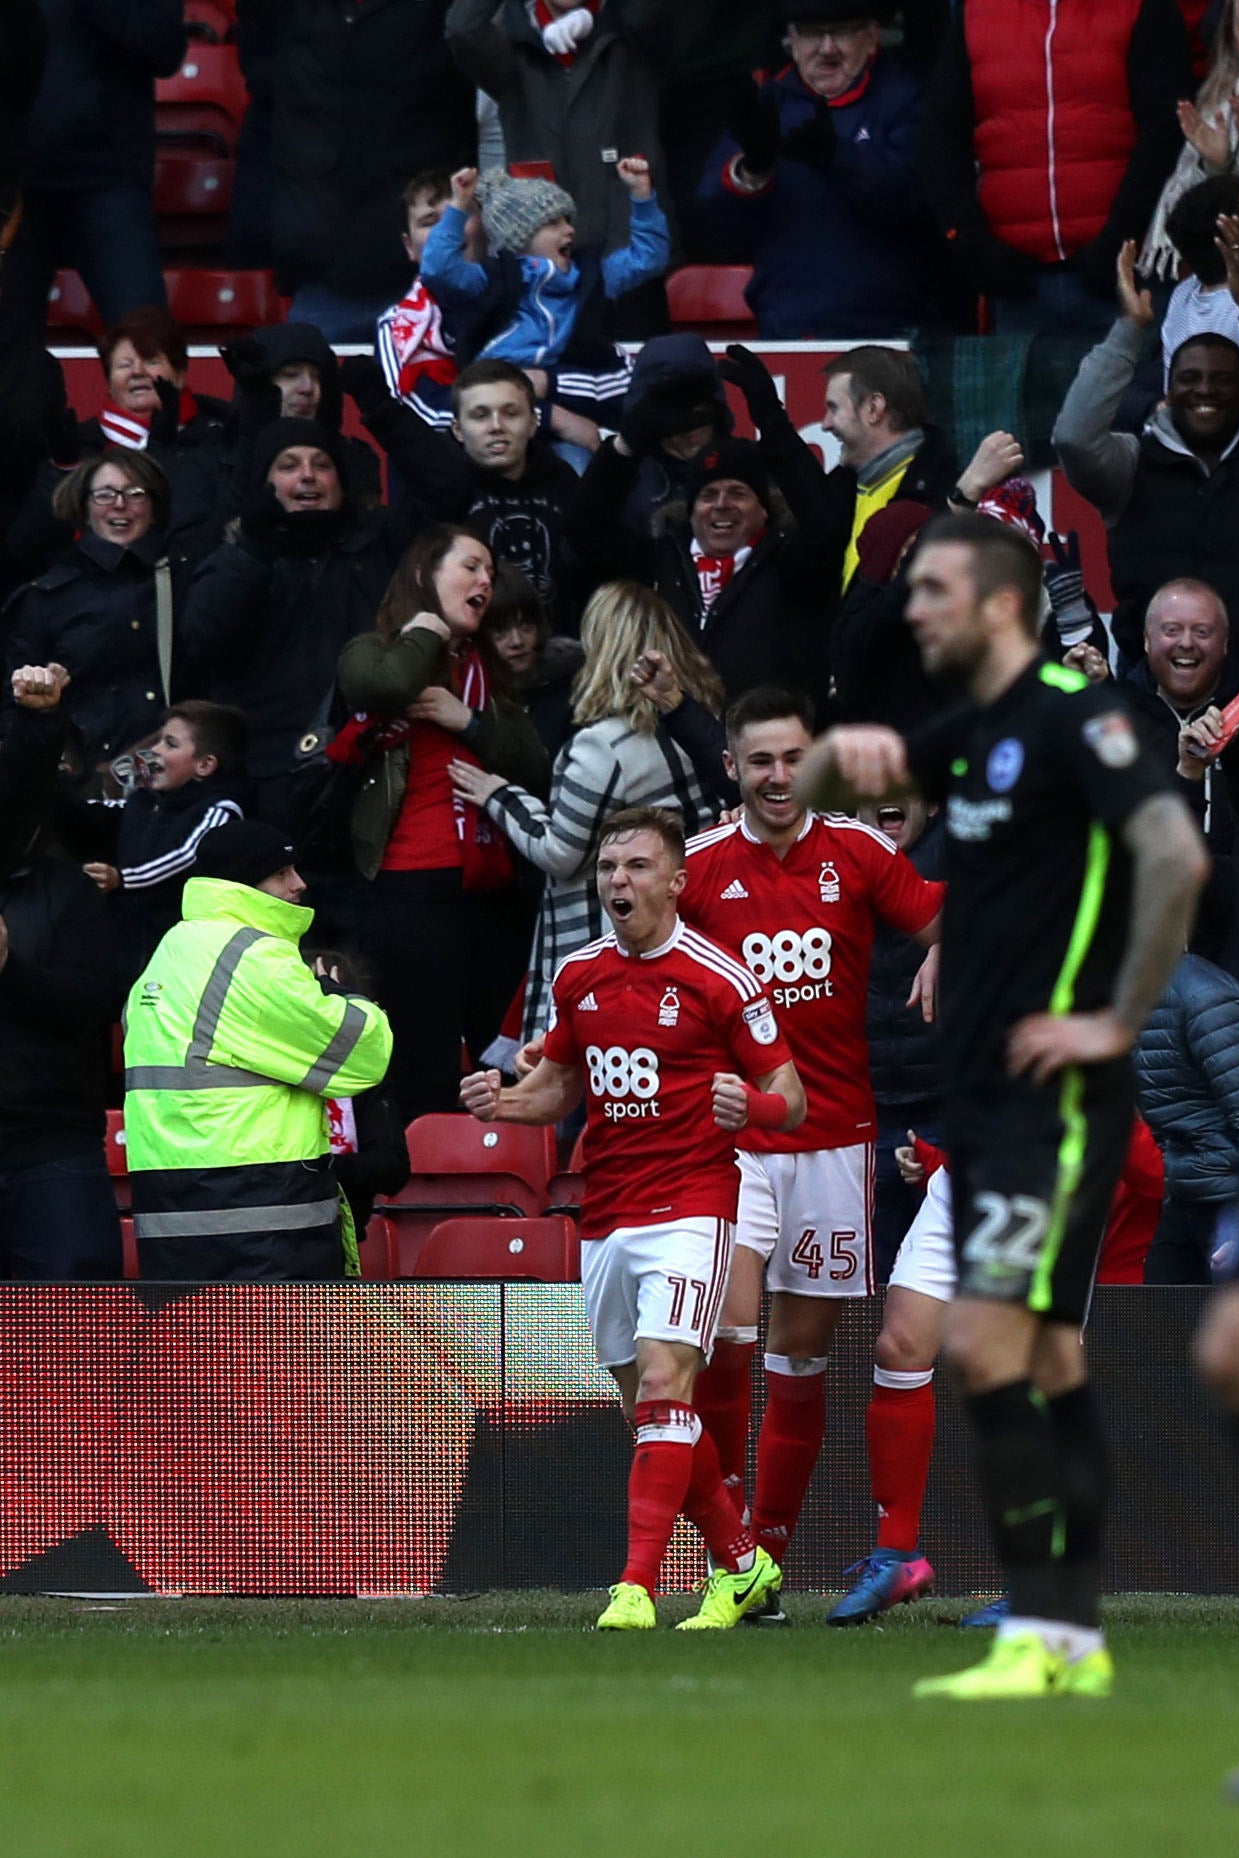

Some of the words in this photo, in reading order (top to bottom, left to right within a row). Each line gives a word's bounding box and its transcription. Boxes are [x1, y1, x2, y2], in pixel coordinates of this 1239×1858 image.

[742, 927, 833, 984] 888
[773, 979, 834, 1009] sport
[585, 1045, 660, 1098] 888
[604, 1100, 661, 1122] sport
[791, 1228, 858, 1282] 45
[962, 1191, 1048, 1269] 22
[667, 1275, 707, 1332] 11
